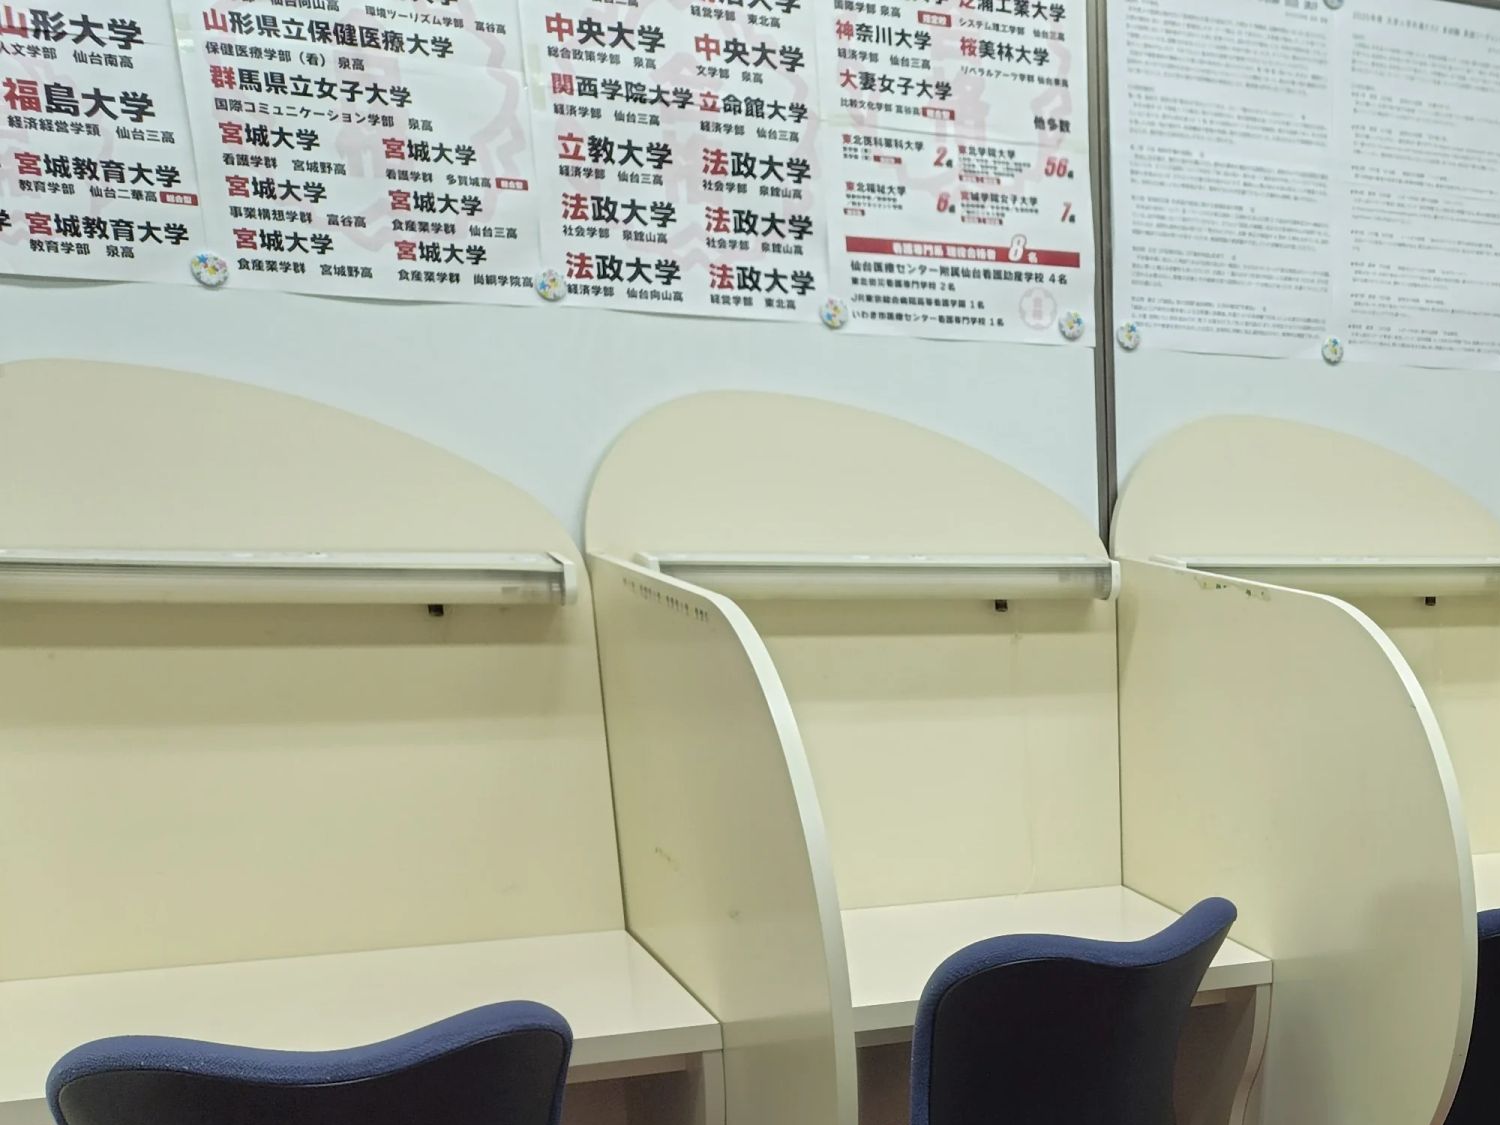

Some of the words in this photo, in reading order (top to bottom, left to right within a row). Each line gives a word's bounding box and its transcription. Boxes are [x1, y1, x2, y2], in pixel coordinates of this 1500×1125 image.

[0, 5, 145, 50] 山形大学
[202, 8, 454, 59] 山形県立保健医療大学
[545, 12, 666, 53] 中央大学
[836, 19, 932, 50] 神奈川大学
[73, 50, 134, 69] 仙台南高
[338, 56, 365, 72] 泉高
[694, 33, 805, 72] 中央大学
[960, 36, 1050, 67] 桜美林大学
[2, 77, 156, 123] 福島大学
[209, 65, 412, 108] 群馬県立女子大学
[551, 73, 695, 109] 関西学院大学
[839, 68, 953, 101] 大妻女子大学
[214, 97, 395, 129] 国際コミュニケーション学部
[408, 118, 433, 132] 泉高
[699, 91, 808, 123] 立命館大学
[116, 126, 175, 144] 仙台三高
[218, 121, 320, 151] 宮城大学
[558, 132, 673, 170] 立教大学
[223, 153, 277, 169] 看護学群
[292, 159, 346, 175] 宮城野高
[382, 137, 477, 166] 宮城大学
[702, 147, 811, 184] 法政大学
[14, 152, 181, 188] 宮城教育大学
[19, 179, 75, 195] 教育学部
[90, 185, 157, 203] 仙台二華高
[225, 175, 327, 203] 宮城大学
[388, 189, 483, 216] 宮城大学
[561, 192, 677, 228] 法政大学
[705, 206, 813, 240] 法政大学
[25, 211, 189, 245] 宮城教育大学
[233, 228, 334, 255] 宮城大学
[563, 224, 610, 239] 社会学部
[29, 239, 90, 255] 教育学部
[106, 245, 135, 259] 泉高
[394, 240, 487, 265] 宮城大学
[320, 264, 373, 279] 宮城野高
[566, 252, 682, 286] 法政大学
[709, 263, 816, 296] 法政大学
